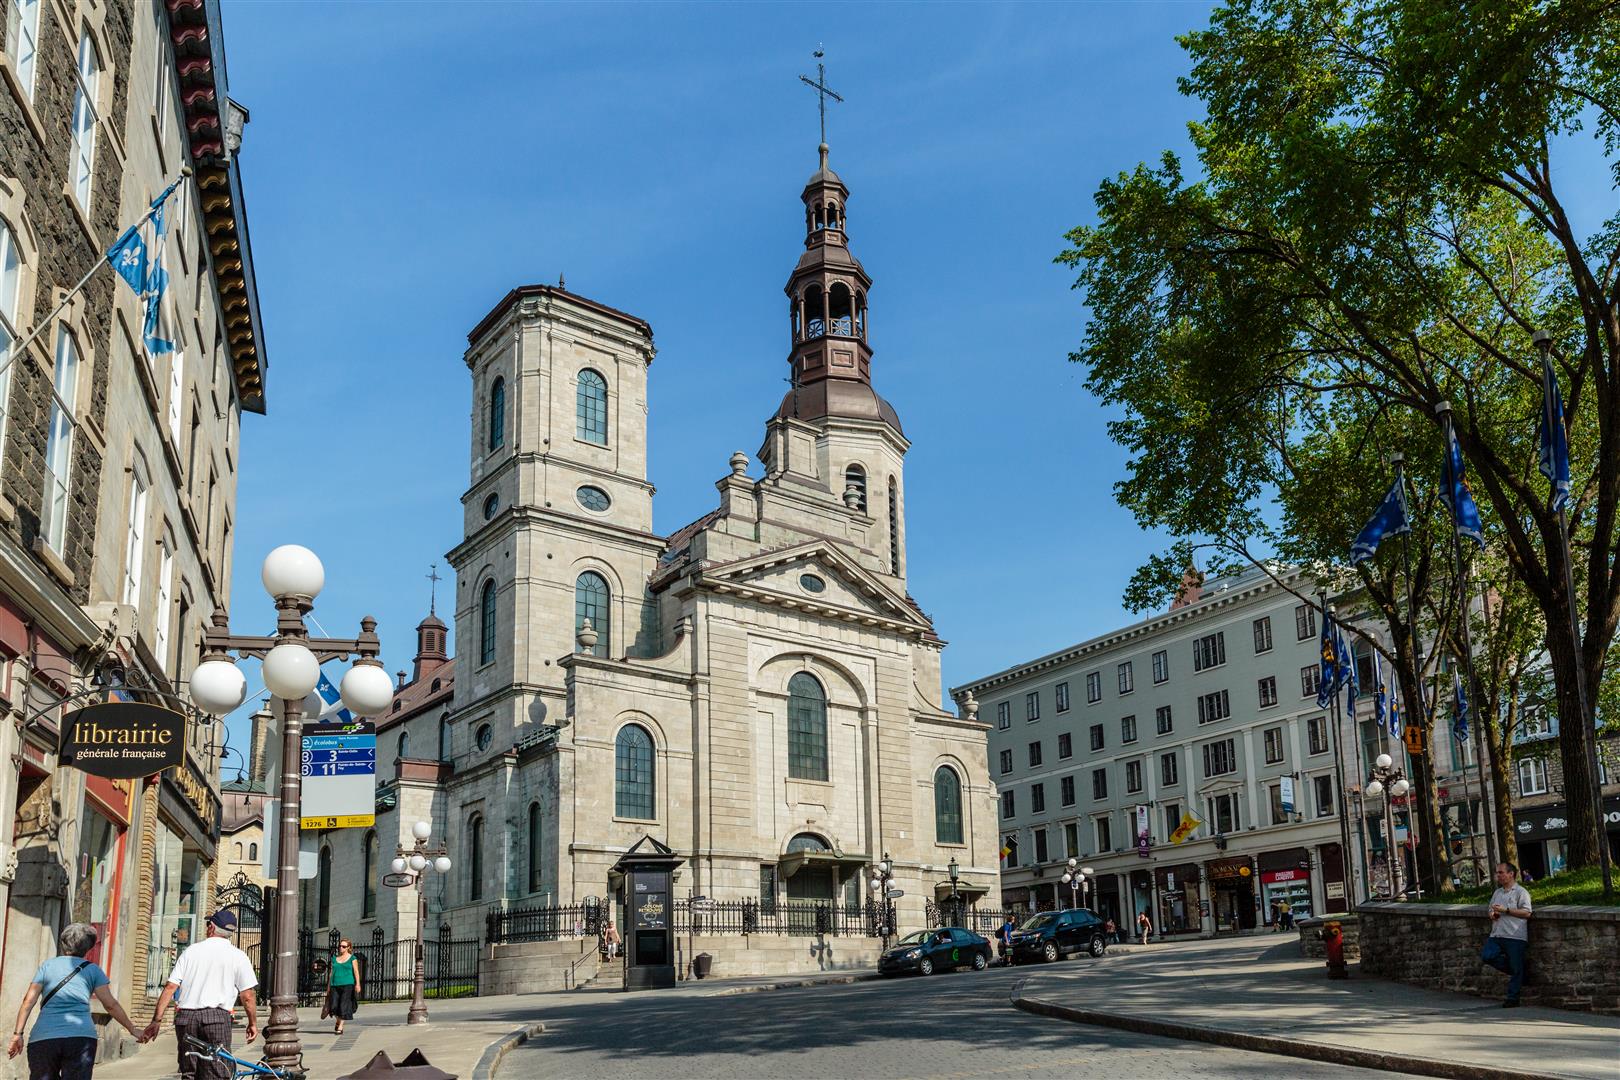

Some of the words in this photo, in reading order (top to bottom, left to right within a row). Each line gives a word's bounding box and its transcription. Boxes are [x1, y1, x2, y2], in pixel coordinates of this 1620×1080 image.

[73, 722, 172, 744] librairie
[76, 748, 119, 760] générale
[122, 748, 166, 760] française
[329, 750, 338, 762] 3
[322, 763, 336, 776] 11
